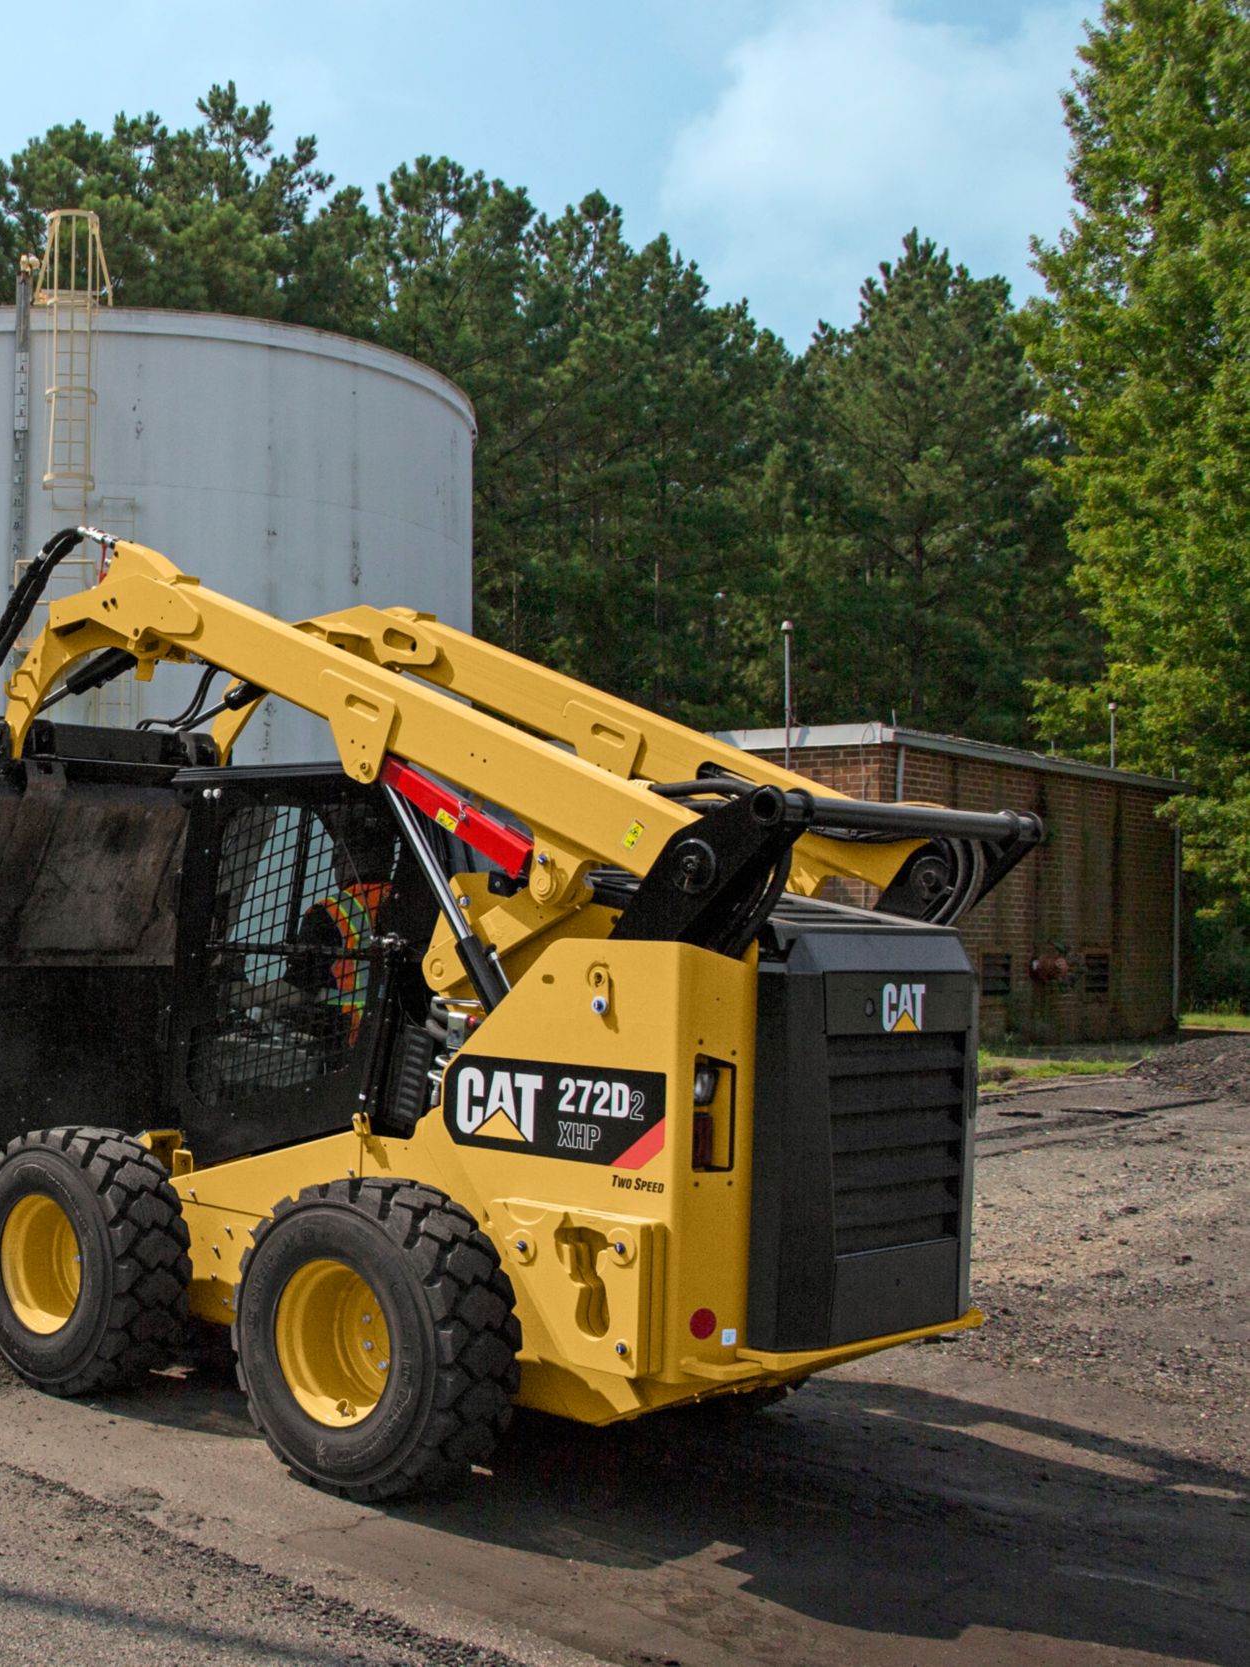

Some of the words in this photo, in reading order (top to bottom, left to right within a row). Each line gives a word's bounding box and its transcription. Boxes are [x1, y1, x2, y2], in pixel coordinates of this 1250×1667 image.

[881, 982, 926, 1032] CAT
[455, 1066, 544, 1143] CAT
[557, 1076, 645, 1121] 272D2
[556, 1120, 602, 1151] XHP
